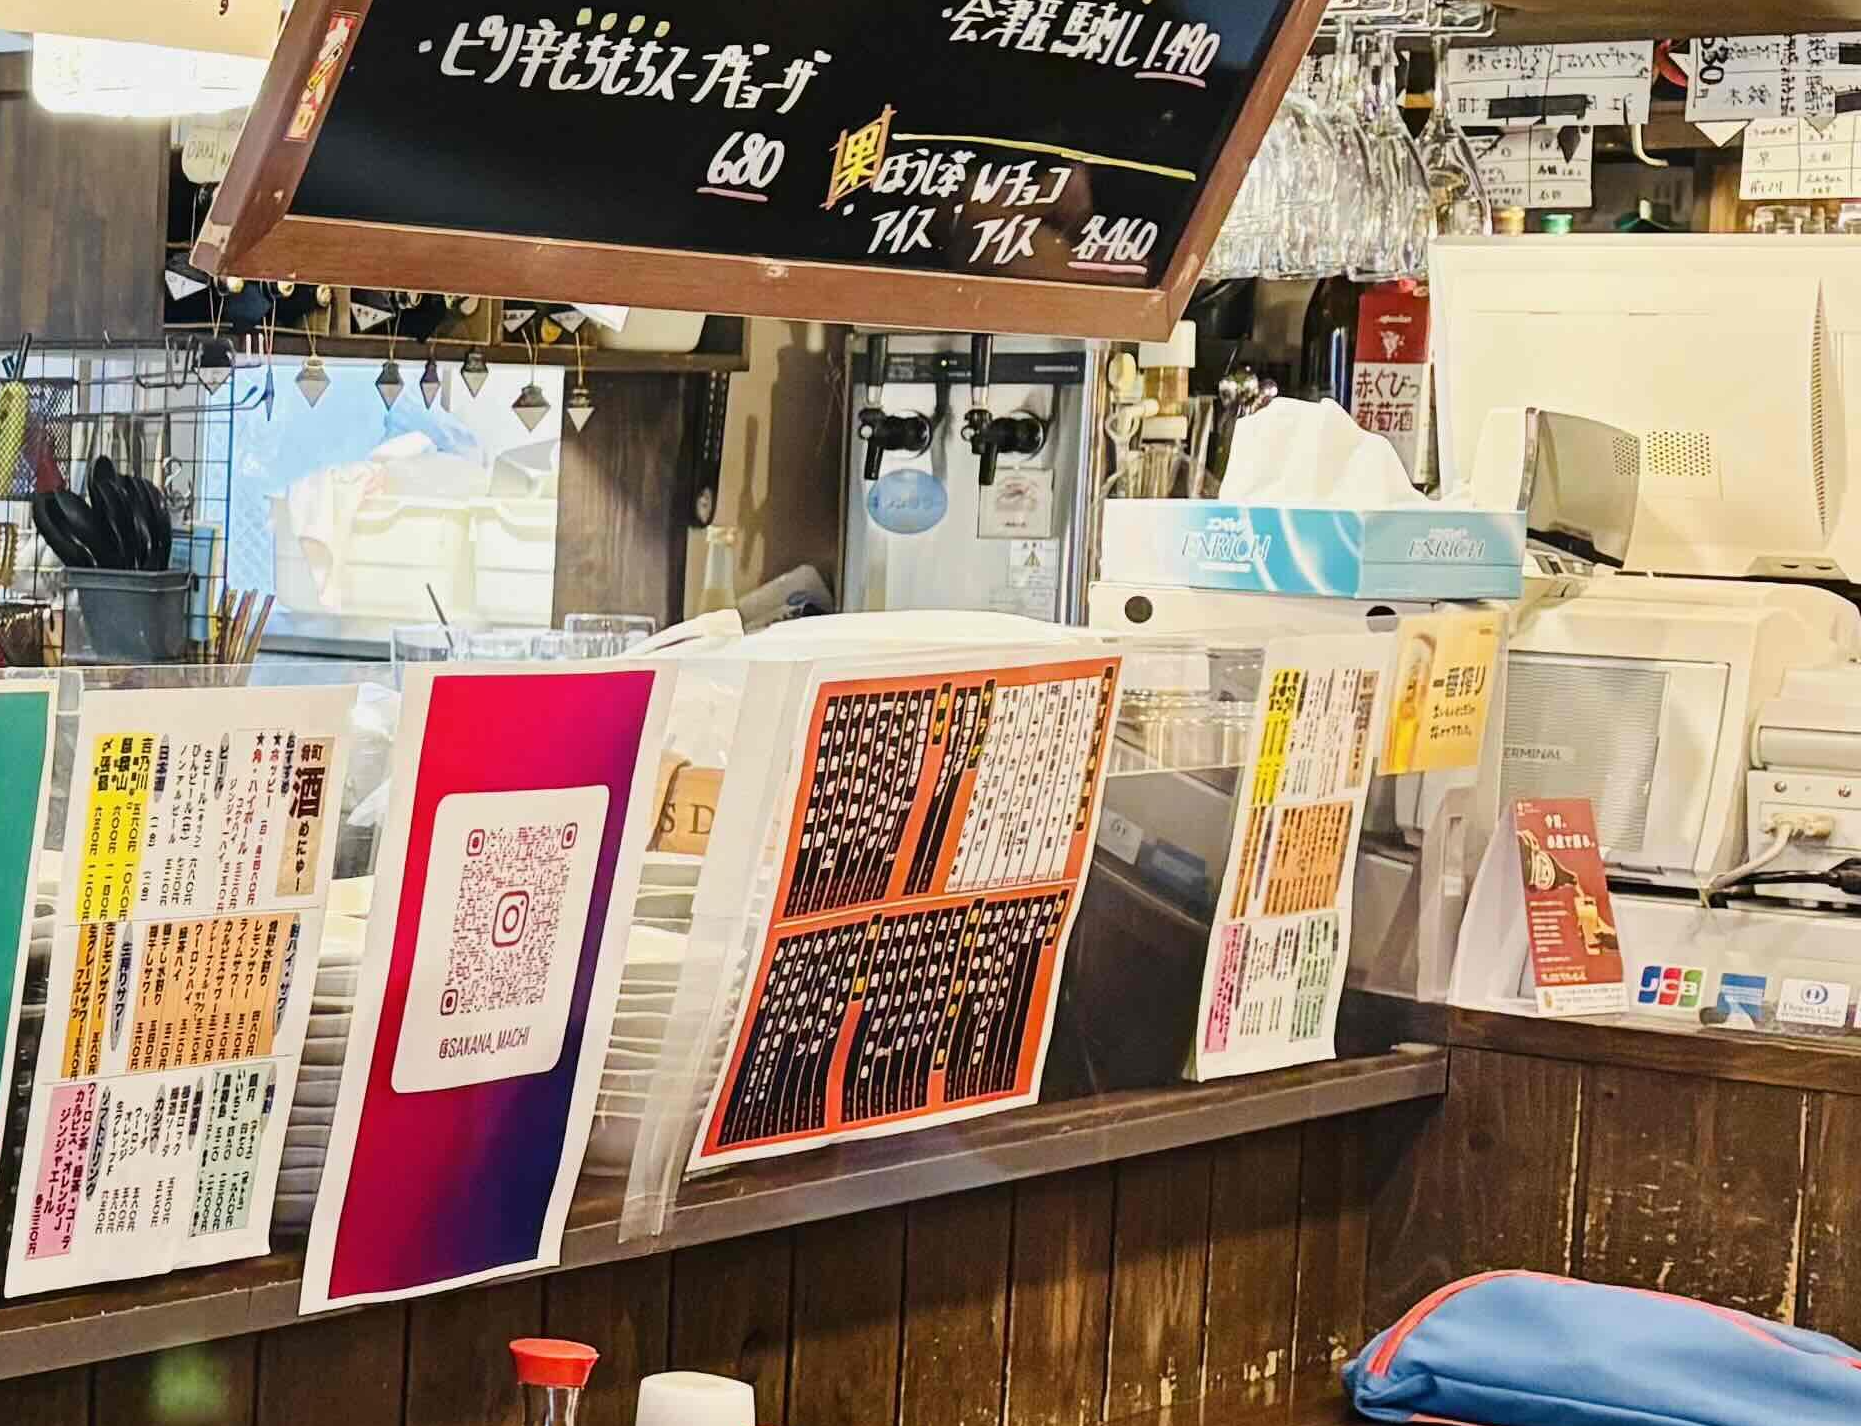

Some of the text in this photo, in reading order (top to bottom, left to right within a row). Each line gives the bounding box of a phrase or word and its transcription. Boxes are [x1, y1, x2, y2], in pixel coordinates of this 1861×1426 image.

[705, 130, 787, 190] 680
[867, 204, 937, 255] アイス
[968, 214, 1042, 265] アイス
[1180, 530, 1272, 563] ENRICH
[1407, 538, 1486, 559] ENRICH
[289, 766, 326, 820] 酒
[1638, 967, 1702, 1007] JCB
[437, 1024, 531, 1061] @SAKANA_MACHI
